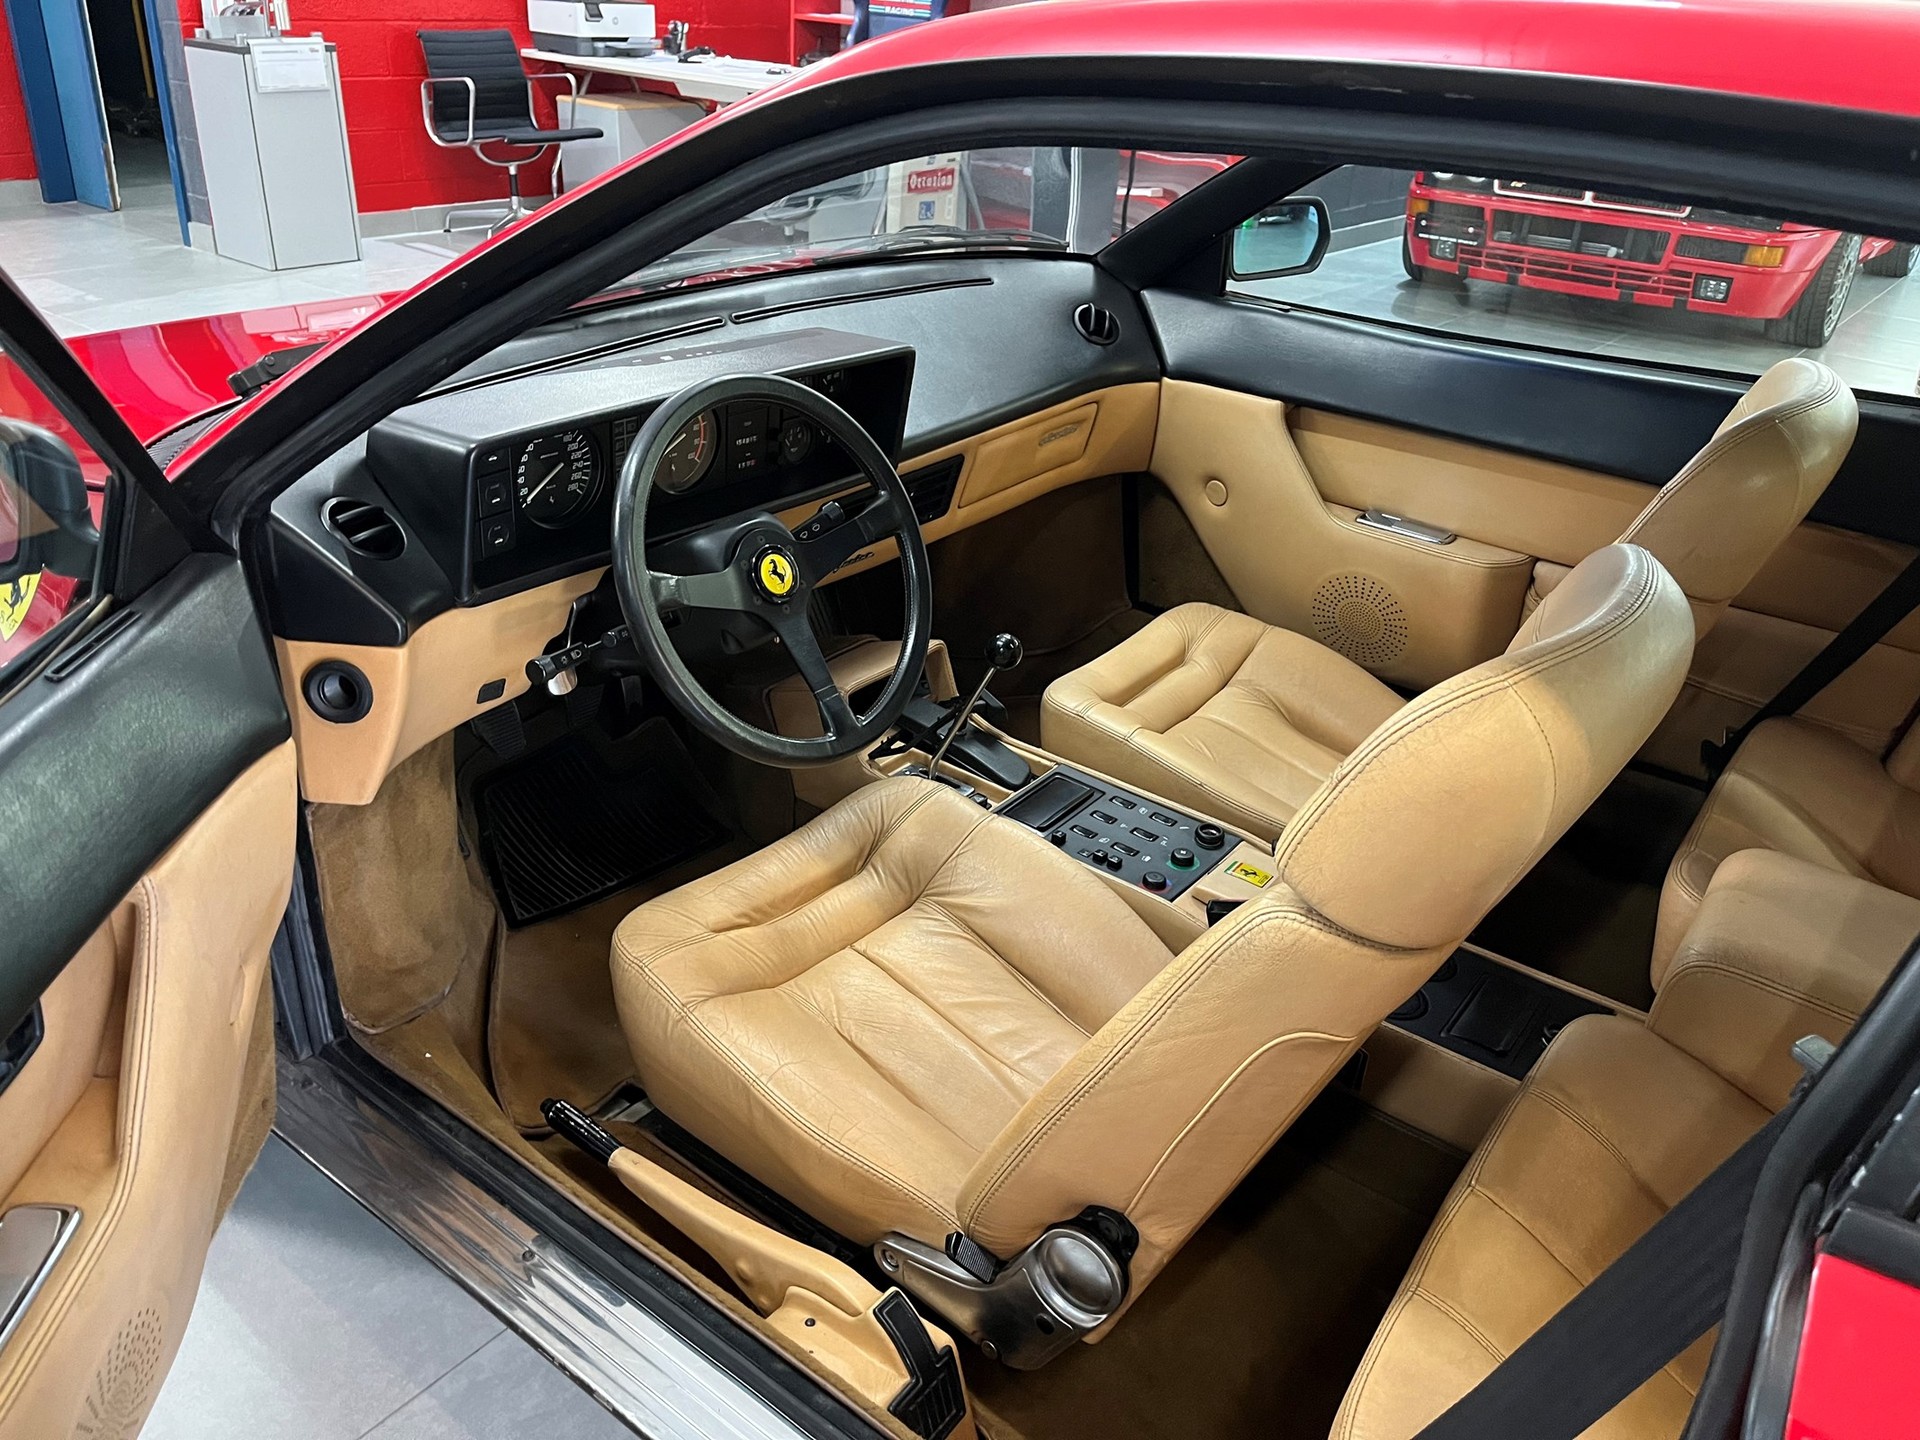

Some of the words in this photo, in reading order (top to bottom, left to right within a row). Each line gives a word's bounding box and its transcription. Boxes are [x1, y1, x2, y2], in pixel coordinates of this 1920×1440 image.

[884, 5, 915, 16] RACING
[567, 442, 578, 451] 200
[571, 451, 582, 460] 220
[572, 460, 584, 469] 240
[520, 487, 528, 496] 20
